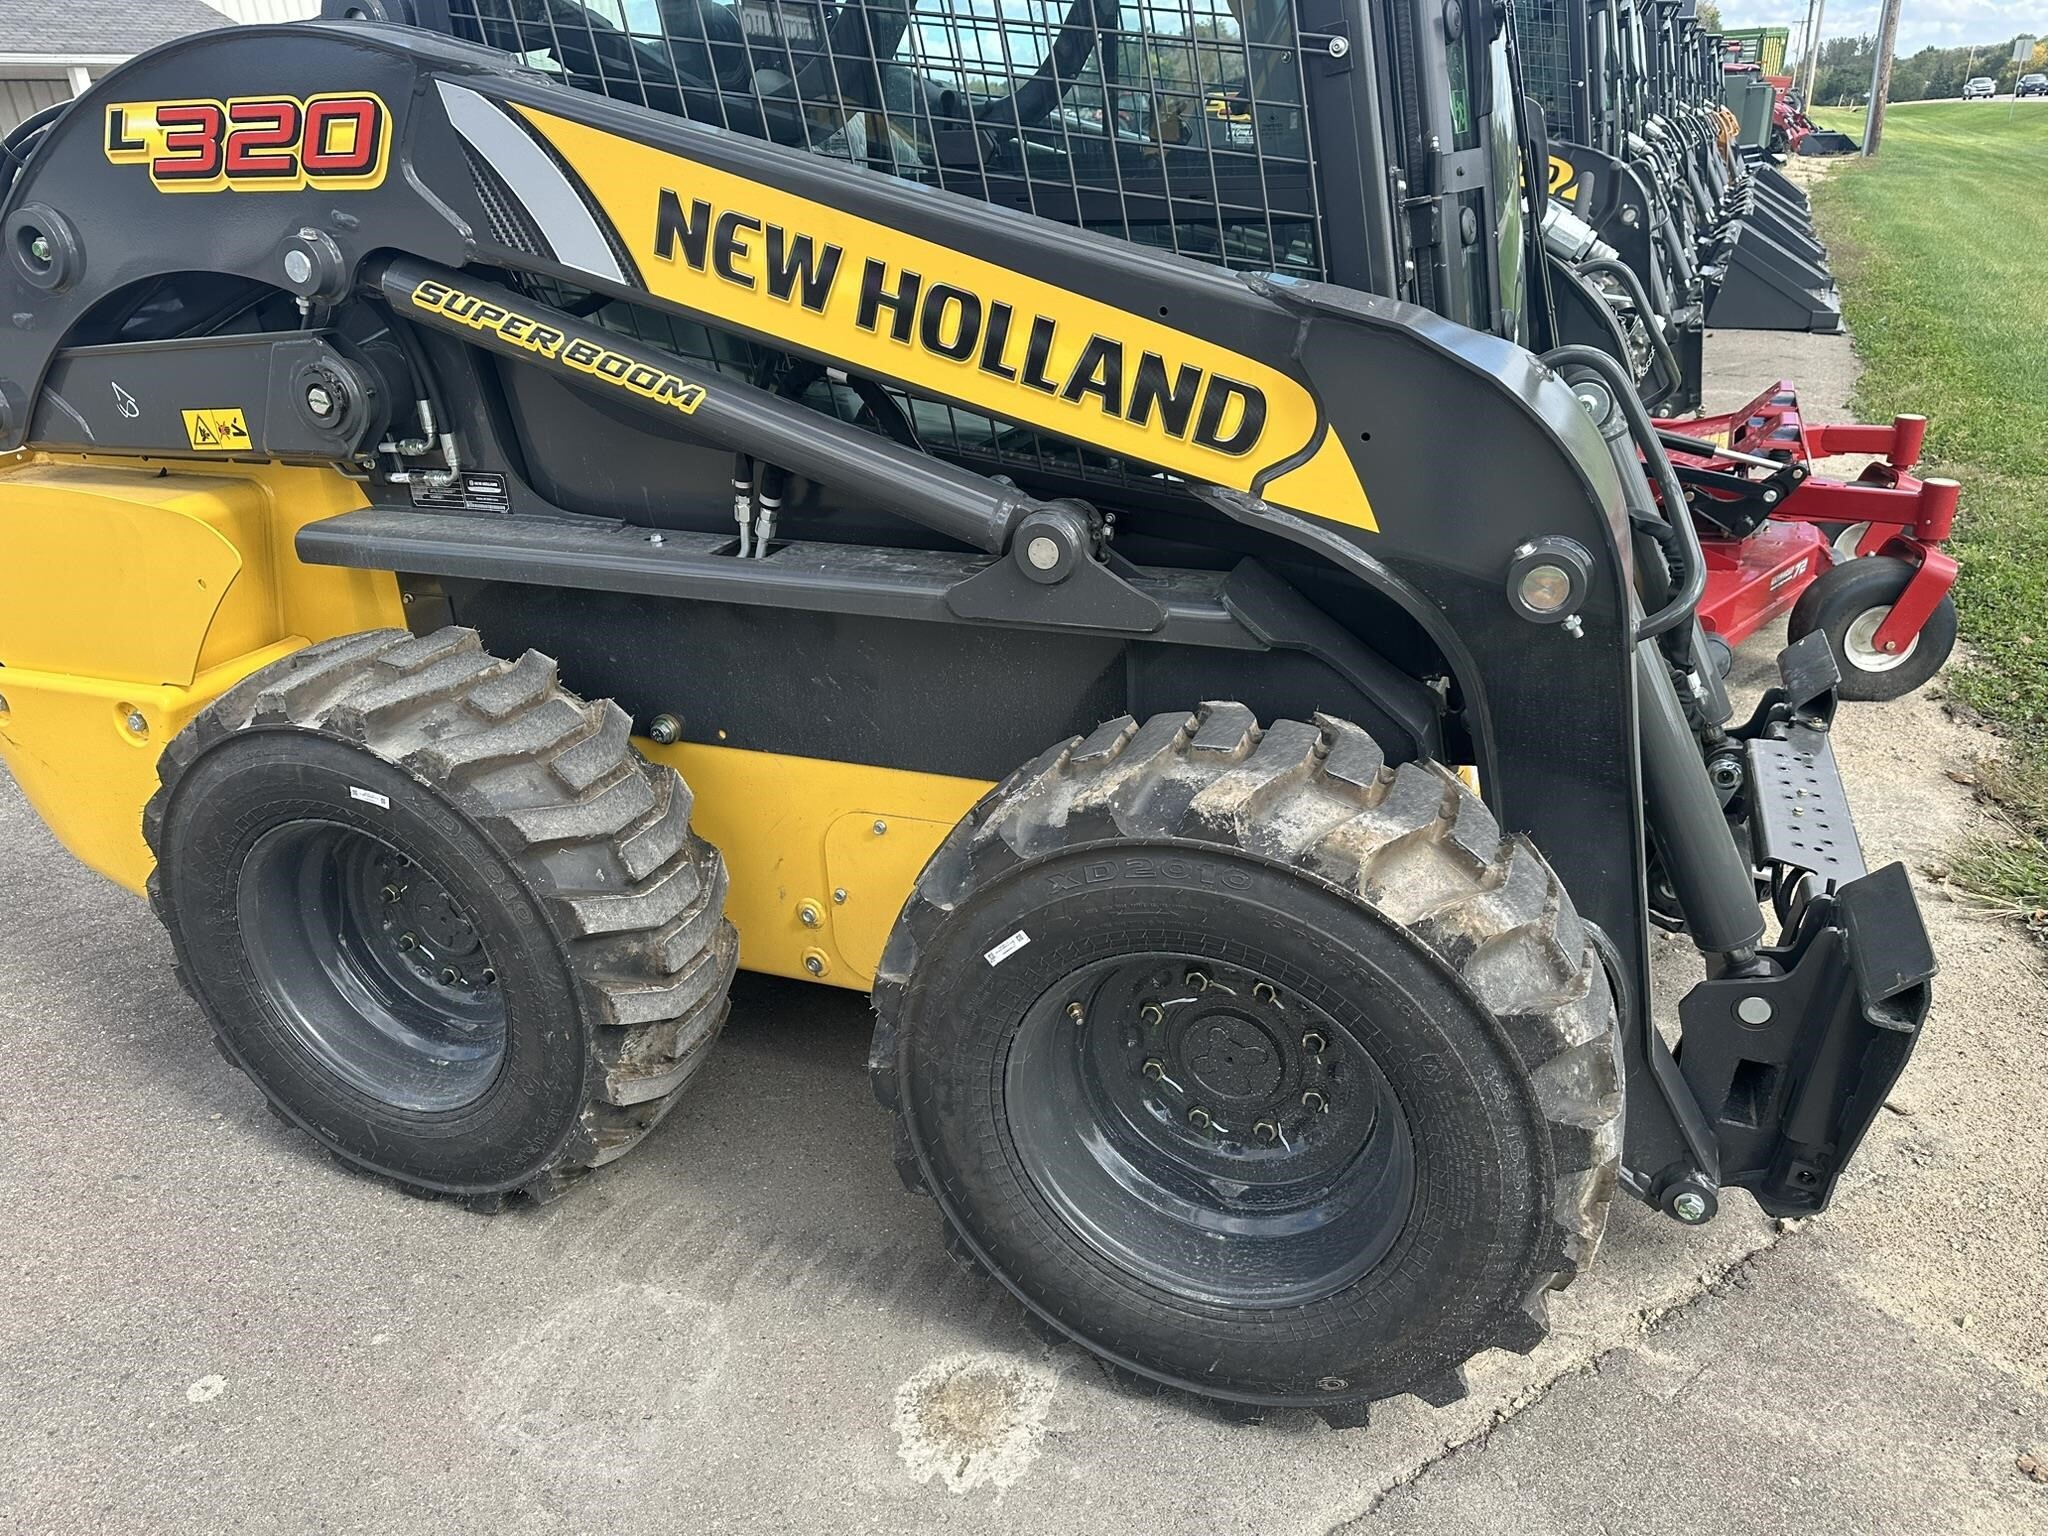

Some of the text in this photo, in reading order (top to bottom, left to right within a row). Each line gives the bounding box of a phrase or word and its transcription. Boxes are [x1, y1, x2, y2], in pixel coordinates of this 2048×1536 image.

[108, 98, 384, 180] L320
[413, 281, 706, 413] SUPER BOOM
[654, 187, 1268, 457] NEW HOLLAND
[1049, 857, 1254, 894] XD2010
